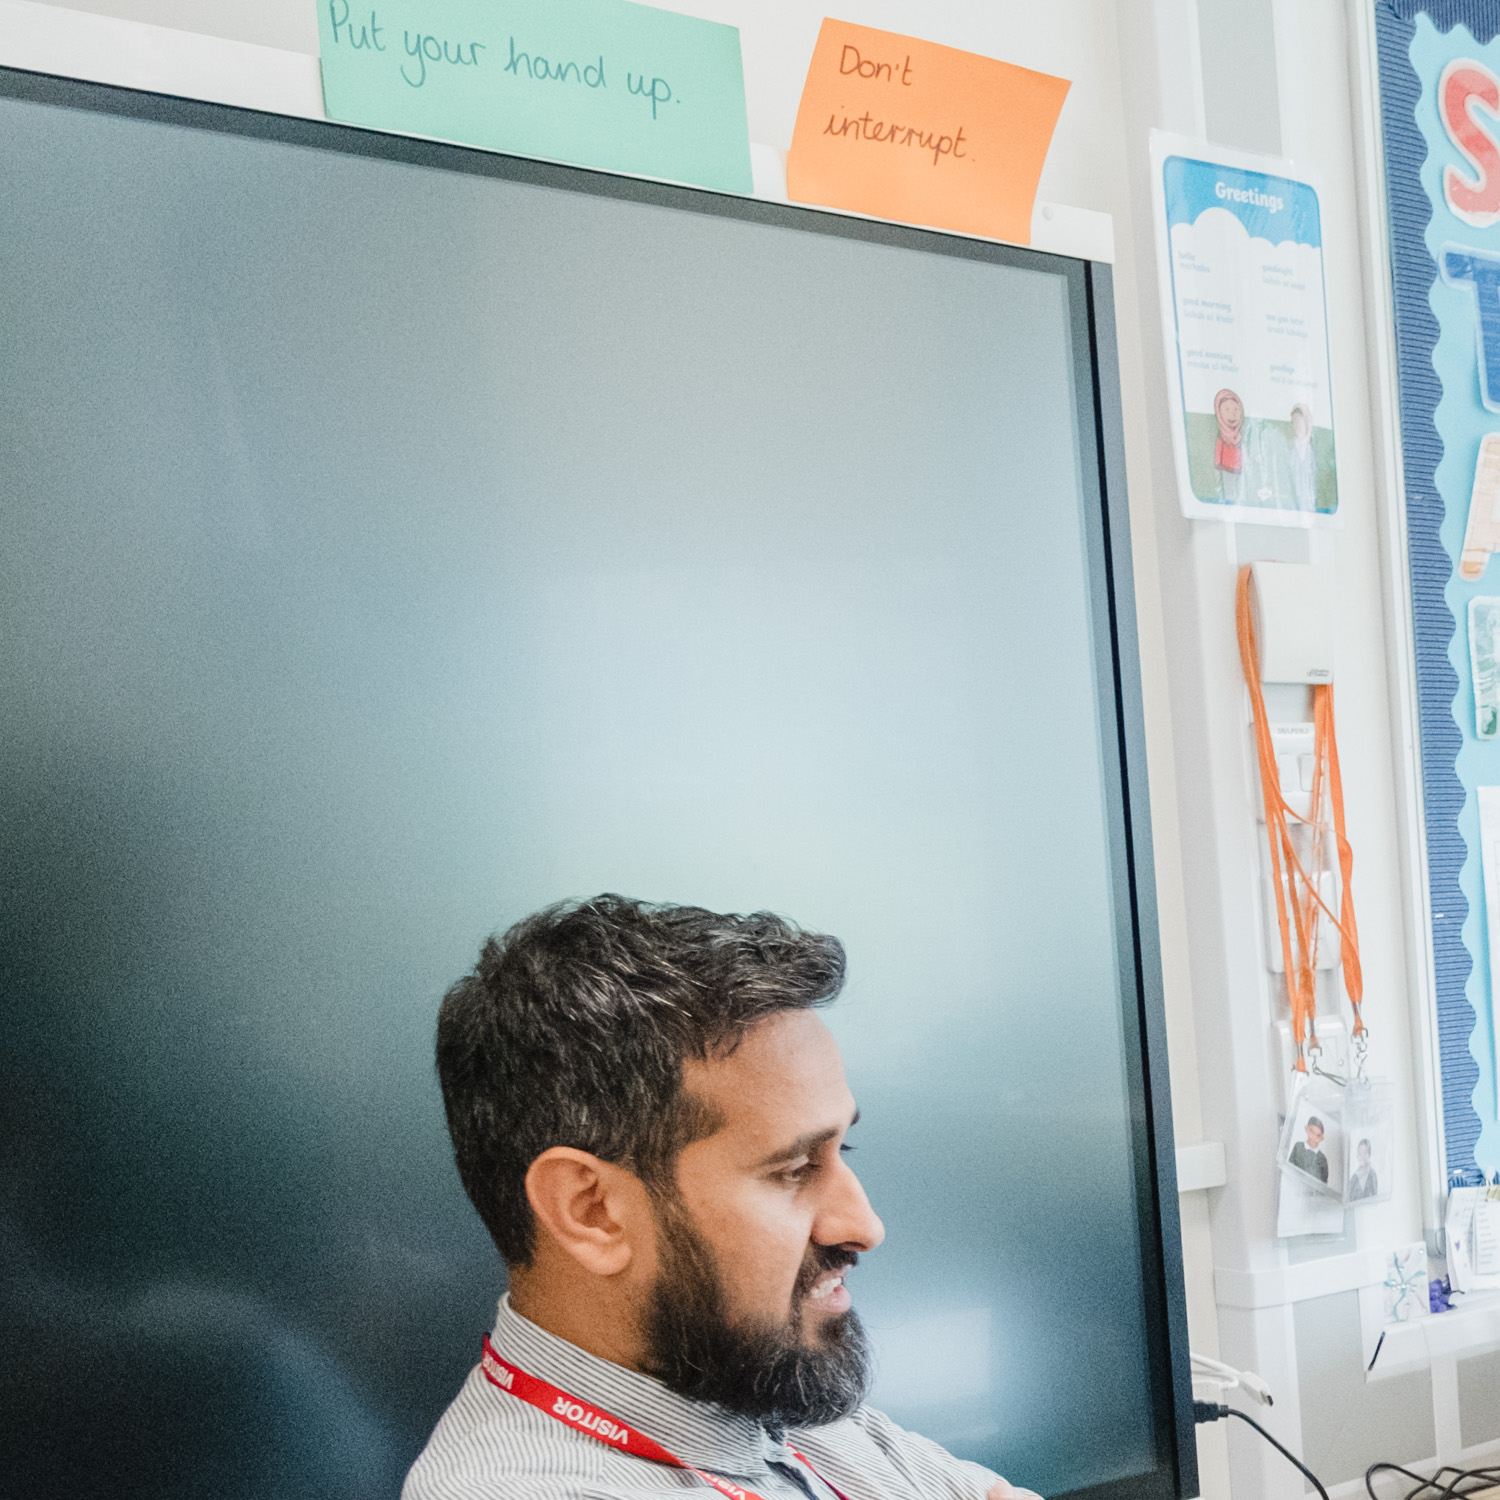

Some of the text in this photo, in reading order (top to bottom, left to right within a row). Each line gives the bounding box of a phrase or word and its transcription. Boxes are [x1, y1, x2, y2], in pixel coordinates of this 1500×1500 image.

[328, 0, 681, 121] Put your hand up.
[838, 45, 914, 88] Don't
[822, 108, 976, 167] interrupt.
[1214, 181, 1285, 214] Greetings
[552, 1396, 629, 1445] VISITOR
